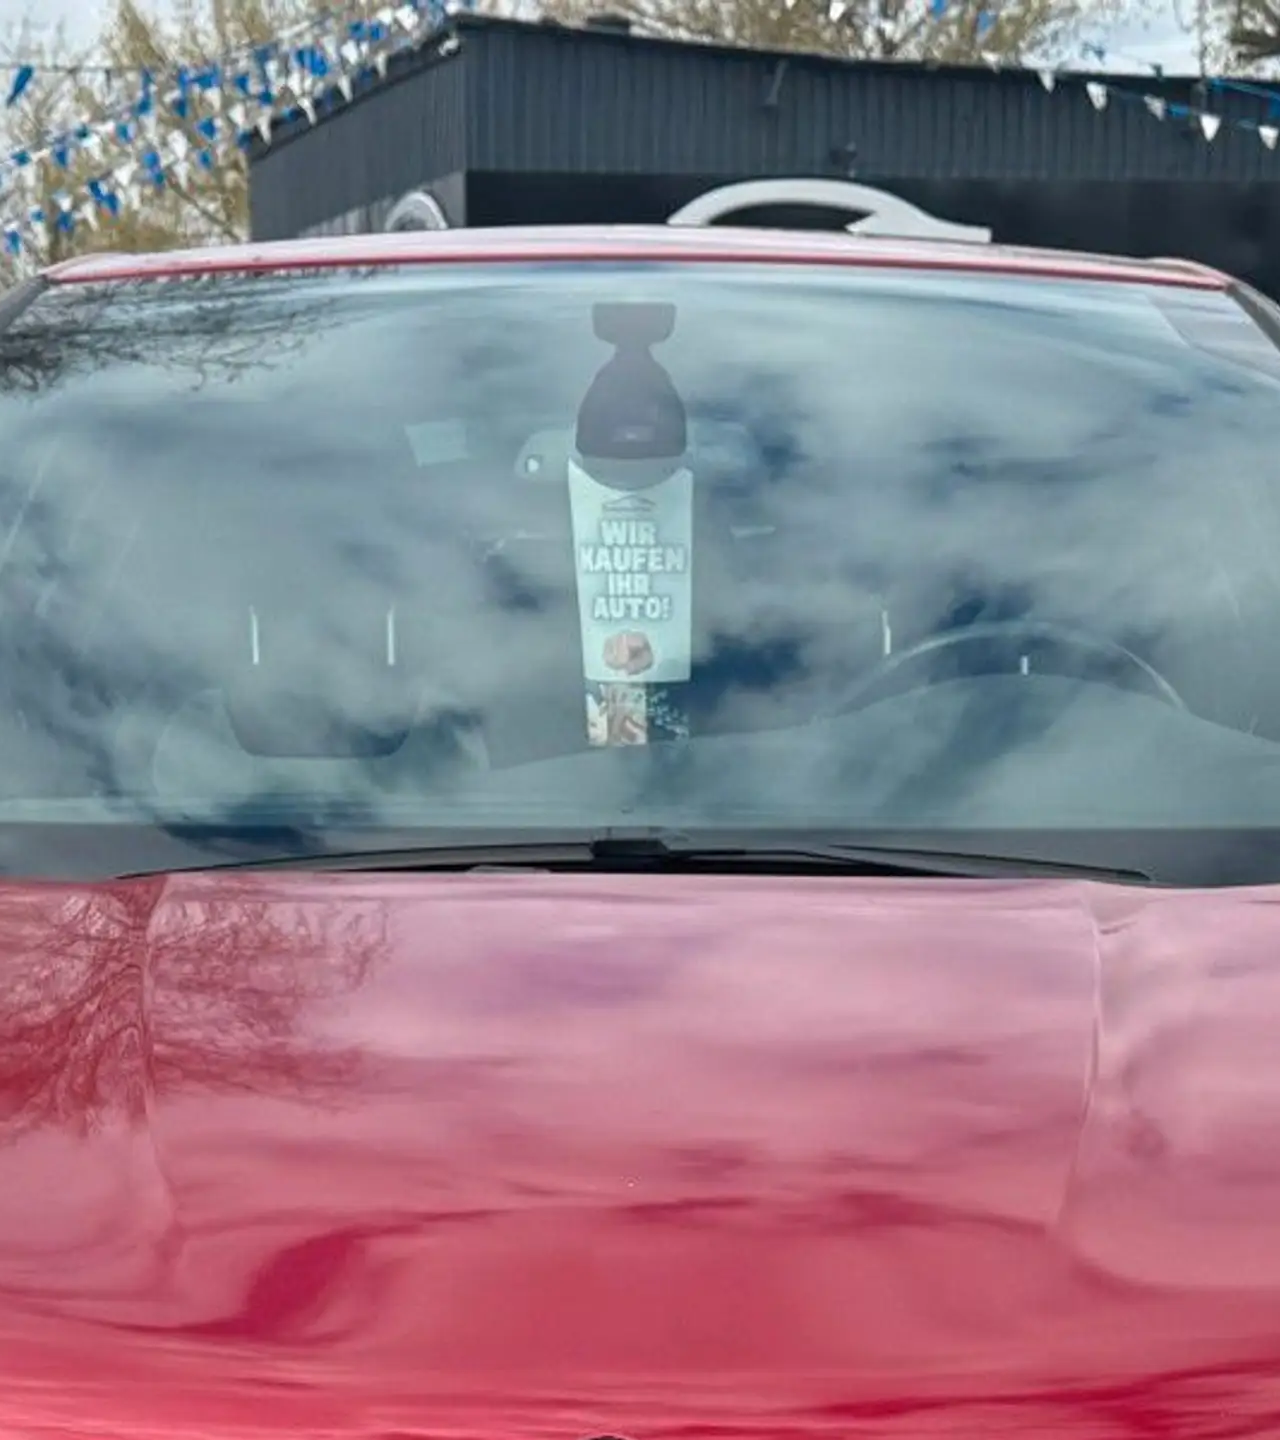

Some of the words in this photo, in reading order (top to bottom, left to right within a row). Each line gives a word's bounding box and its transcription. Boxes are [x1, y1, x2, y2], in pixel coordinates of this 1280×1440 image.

[599, 520, 657, 547] WIR
[580, 545, 685, 573] KAUFEN
[607, 573, 651, 597] IHR
[593, 597, 672, 621] AUTO!
